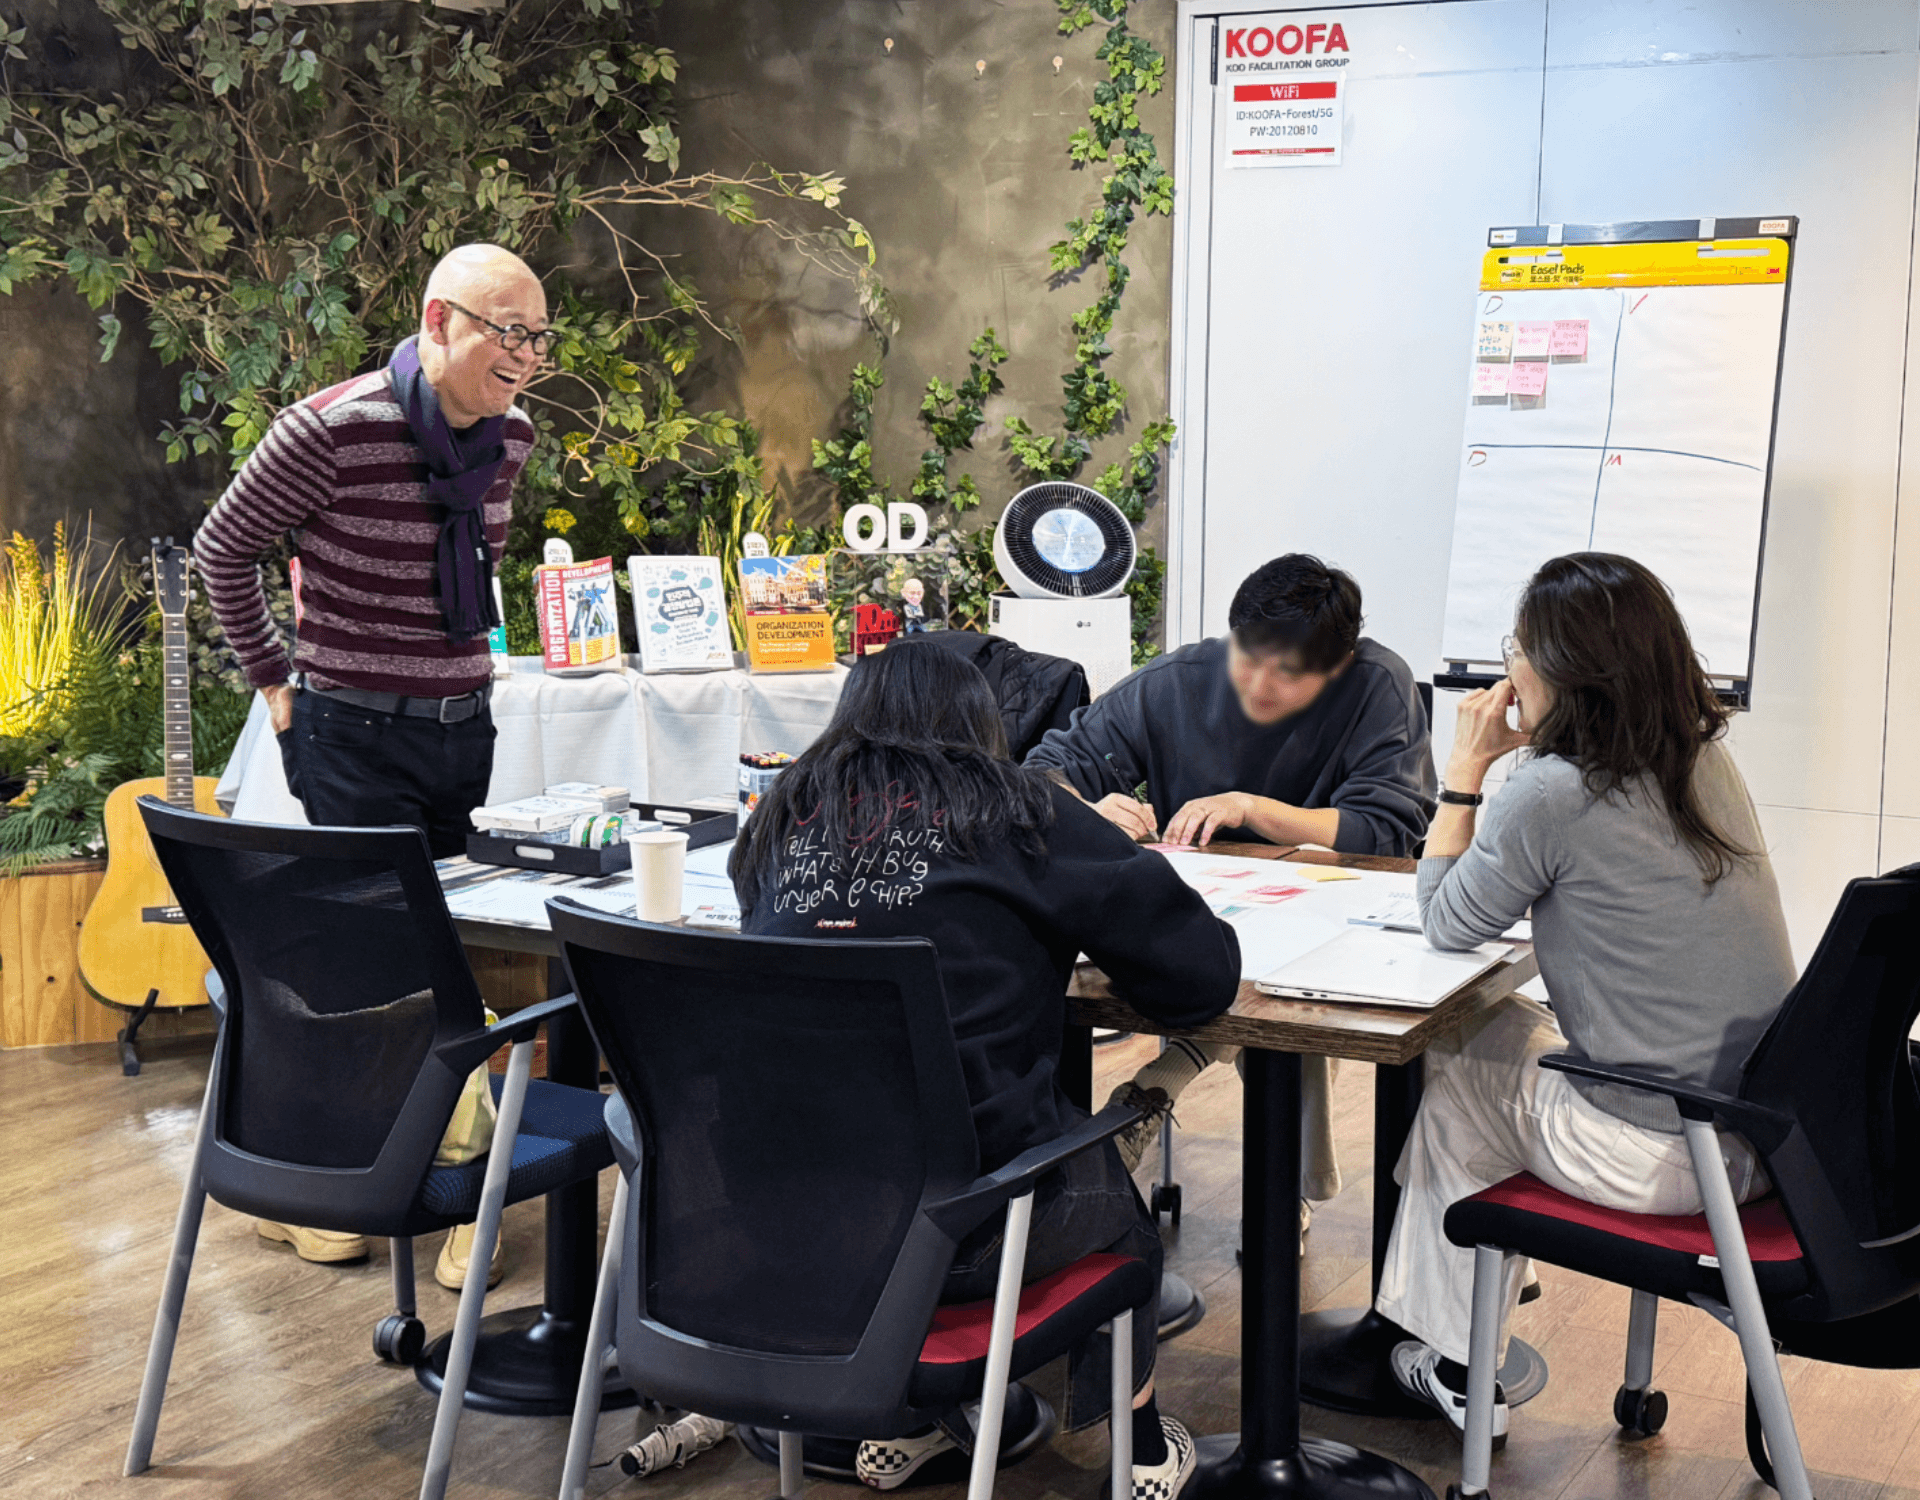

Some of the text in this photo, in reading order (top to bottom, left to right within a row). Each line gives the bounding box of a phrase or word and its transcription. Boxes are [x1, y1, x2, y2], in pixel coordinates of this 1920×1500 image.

[1225, 23, 1350, 58] KOOFA
[1225, 58, 1350, 73] KOO FACILITATION GROUP
[1269, 85, 1300, 99] WiFi
[1530, 262, 1585, 275] Easel Pads
[842, 502, 929, 554] OD
[544, 569, 567, 663] ORGANIZATION
[756, 620, 825, 631] ORGANIZATION
[757, 629, 825, 640] DEVELOPMENT
